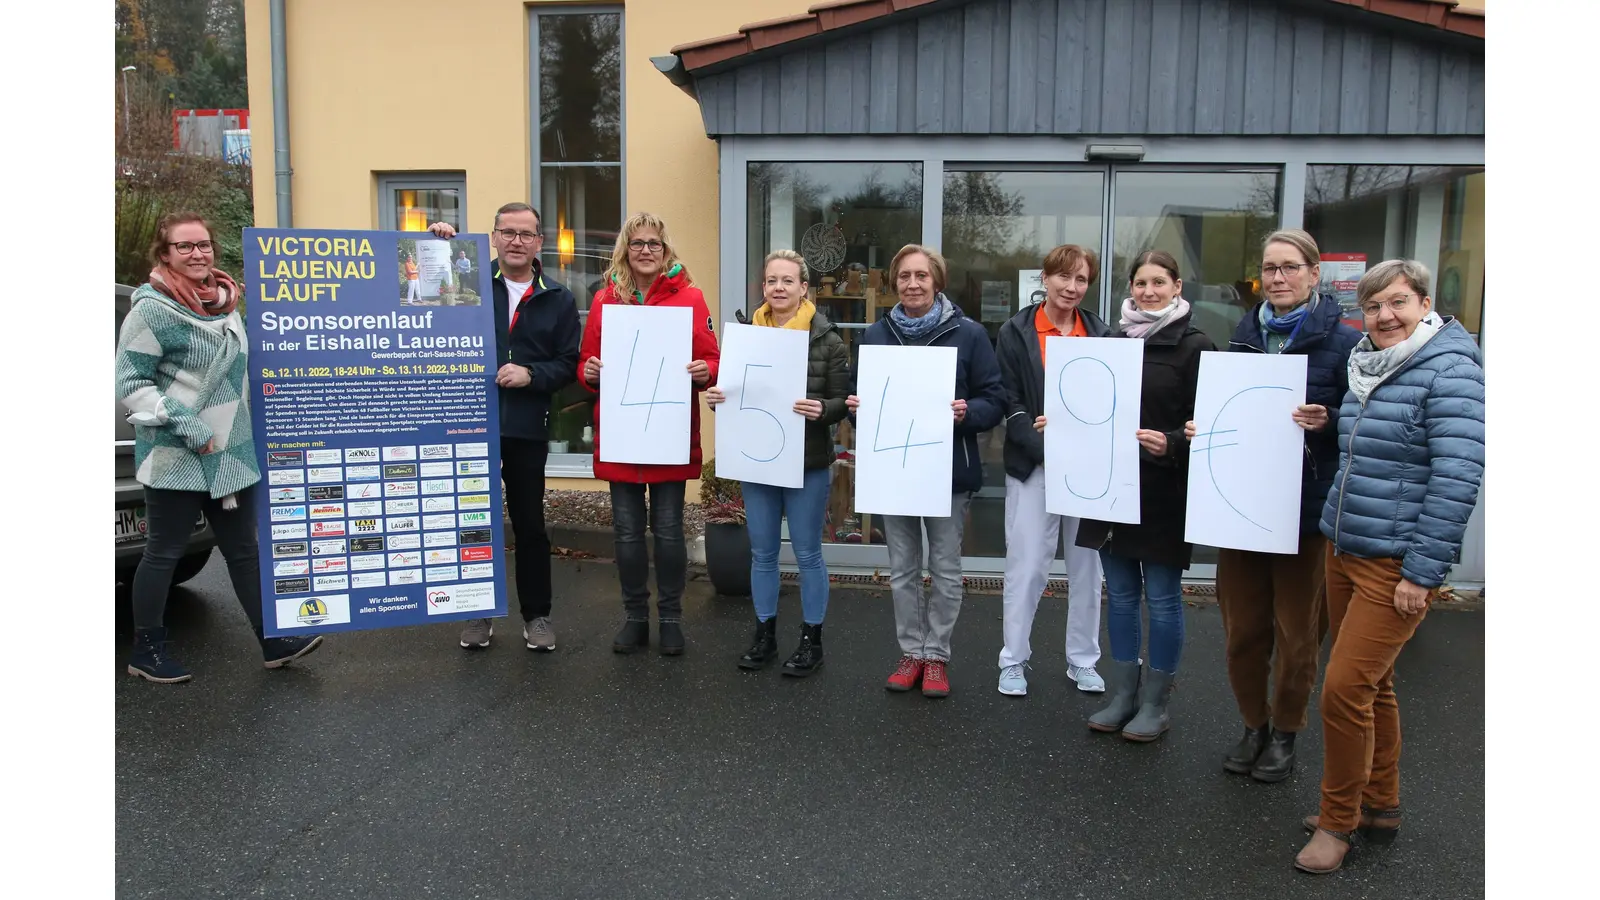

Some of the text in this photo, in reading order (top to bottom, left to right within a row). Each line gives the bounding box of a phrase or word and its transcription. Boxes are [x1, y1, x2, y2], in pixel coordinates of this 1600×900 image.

[257, 236, 374, 256] VICTORIA
[259, 260, 376, 279] LAUENAU
[260, 278, 341, 302] LÄUFT
[261, 310, 433, 335] Sponsorenlauf
[262, 333, 484, 351] in der Eishalle Lauenau
[371, 351, 416, 359] Gewerbepark
[418, 350, 478, 358] Carl-Sasse-Straße
[262, 368, 277, 378] Sa.
[279, 368, 292, 378] 12.
[294, 367, 307, 377] 11.
[308, 367, 333, 378] 2022,
[334, 366, 358, 376] 18-24
[360, 366, 376, 376] Uhr
[383, 365, 397, 375] So.
[398, 365, 411, 374] 13.
[413, 365, 425, 374] 11.
[426, 364, 449, 375] 2022,
[450, 364, 468, 373] 9-18
[470, 363, 485, 373] Uhr
[620, 330, 685, 432] 4
[740, 364, 786, 462] 5
[874, 376, 943, 469] 4
[1192, 386, 1293, 532] €
[272, 508, 298, 516] FREMY
[378, 603, 418, 613] Sponsoren!
